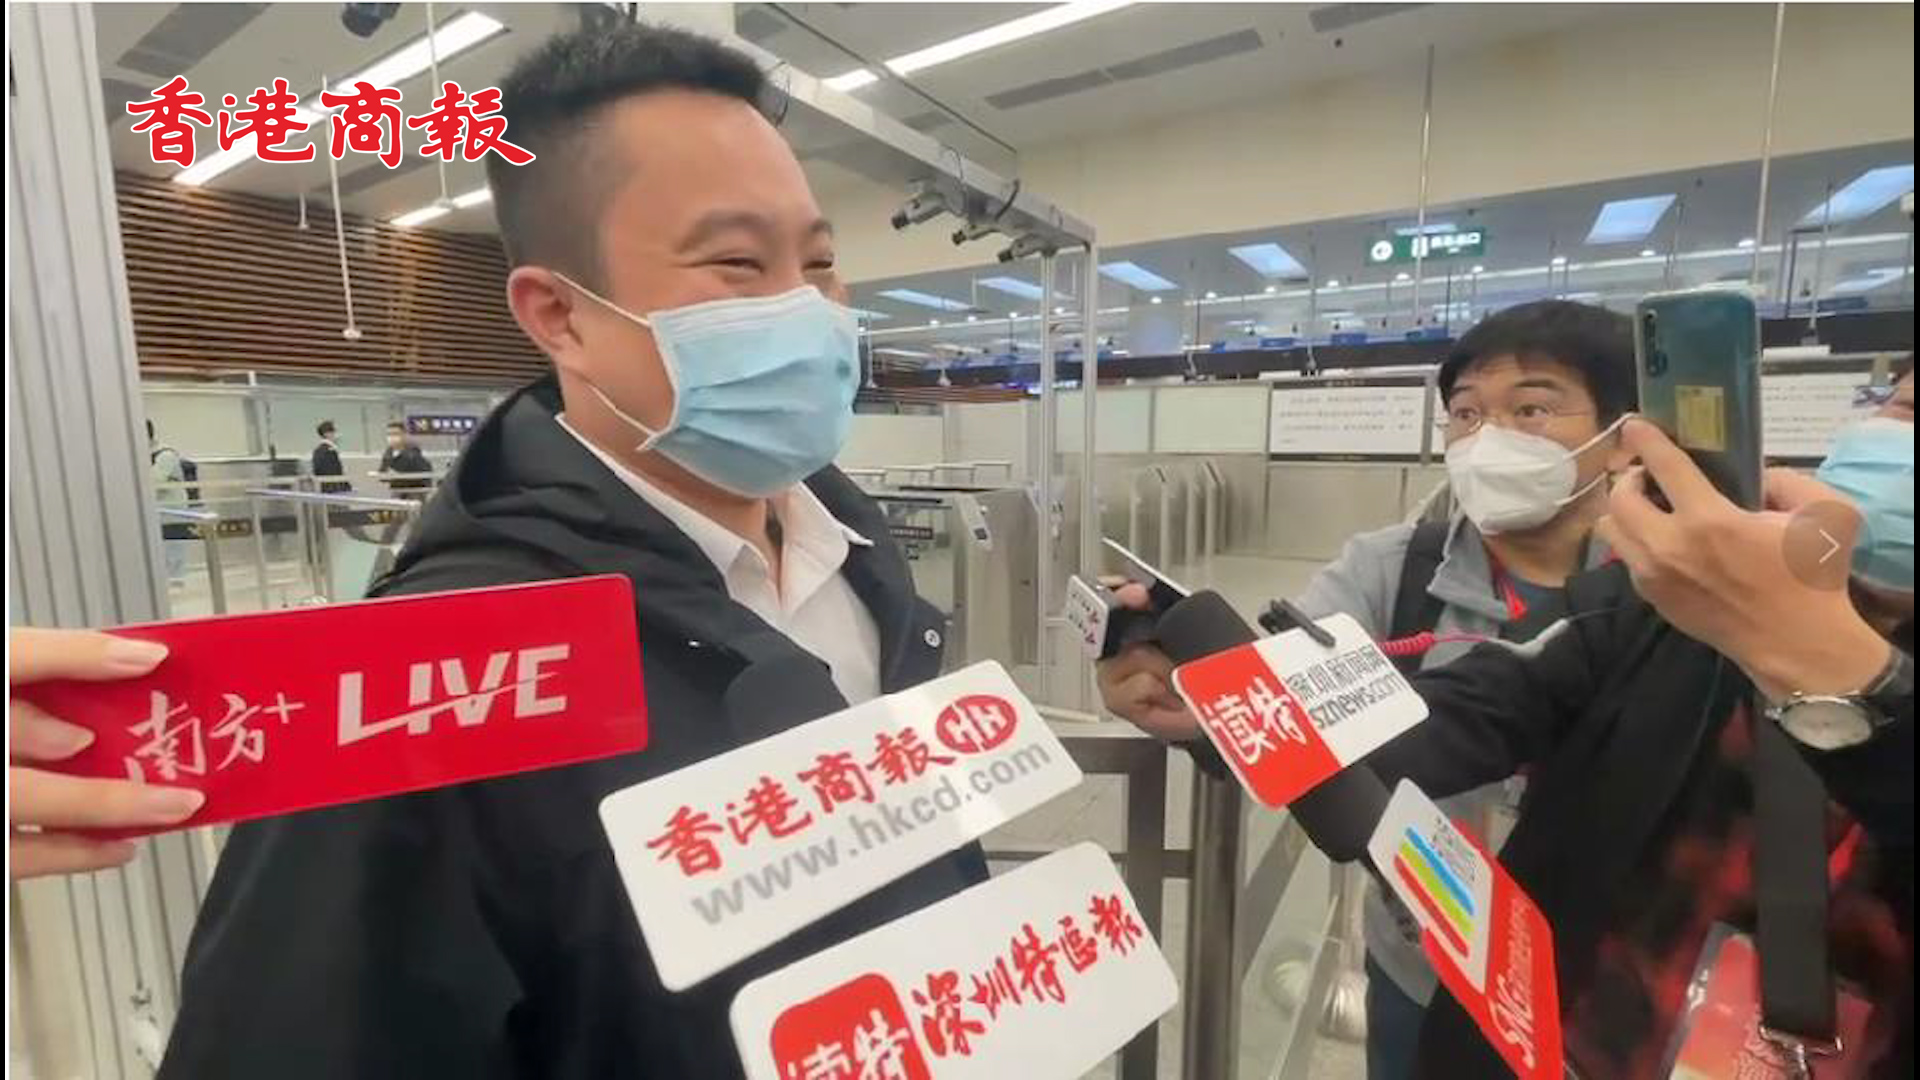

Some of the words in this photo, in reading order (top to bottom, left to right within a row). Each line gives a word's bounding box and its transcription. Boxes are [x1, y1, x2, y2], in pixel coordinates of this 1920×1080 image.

[336, 643, 570, 746] LIVE
[646, 726, 957, 878] 香港商報
[690, 742, 1053, 926] www.hkcd.com
